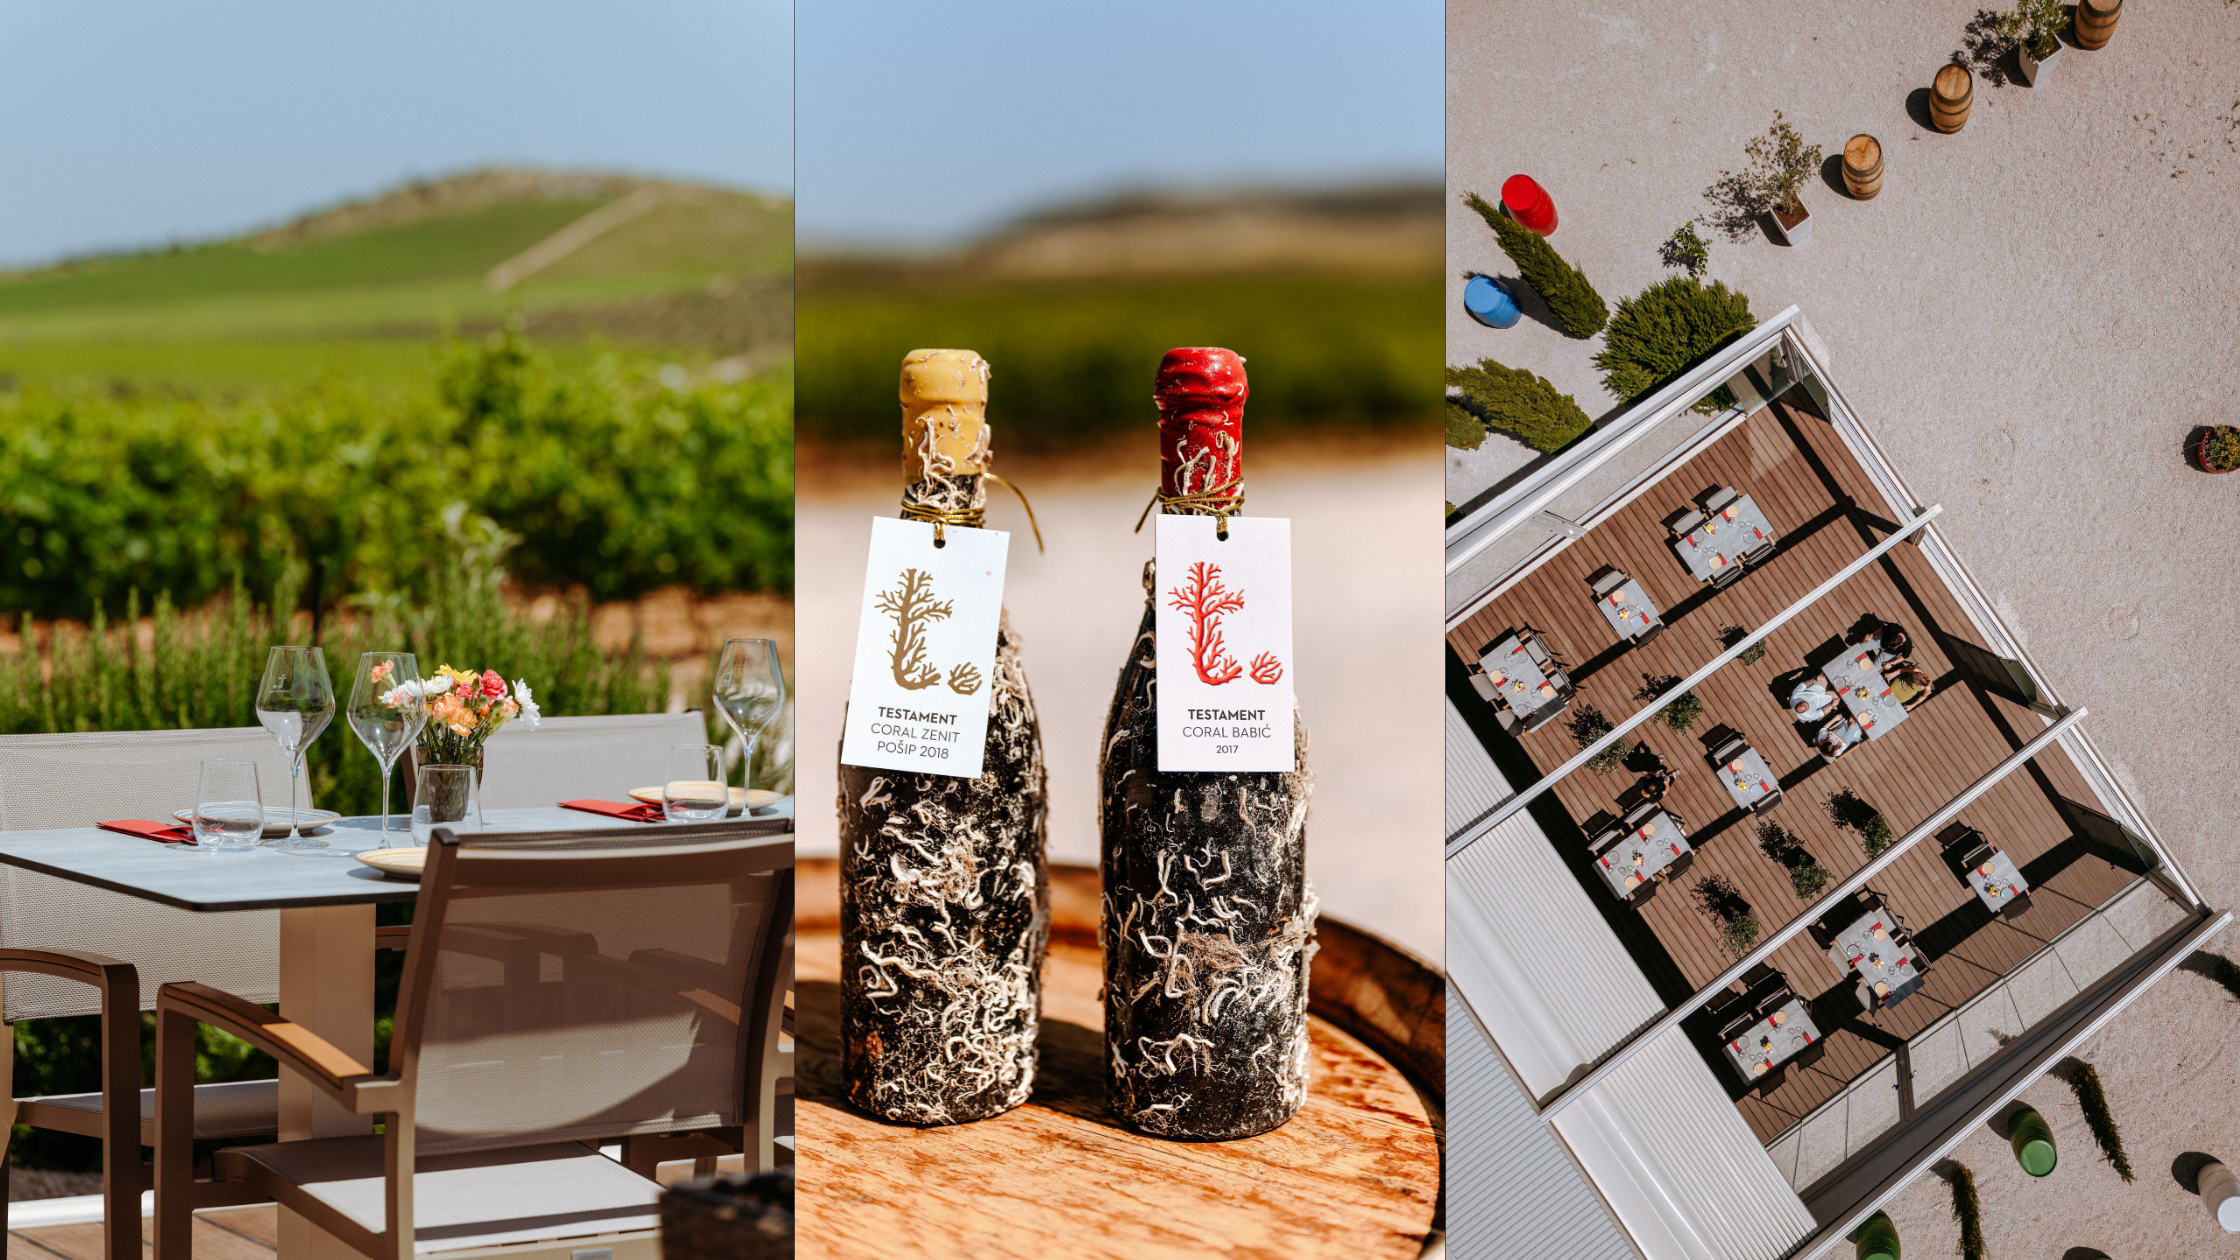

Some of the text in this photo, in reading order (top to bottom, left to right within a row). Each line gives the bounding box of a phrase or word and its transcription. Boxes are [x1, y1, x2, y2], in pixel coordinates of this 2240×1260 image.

[878, 706, 958, 726] TESTAMENT
[1187, 709, 1266, 721] TESTAMENT
[871, 723, 960, 743] CORAL ZENIT
[1182, 723, 1272, 738] CORAL BABIĆ
[877, 740, 949, 759] POŠIP 2018
[1216, 744, 1239, 754] 2017
